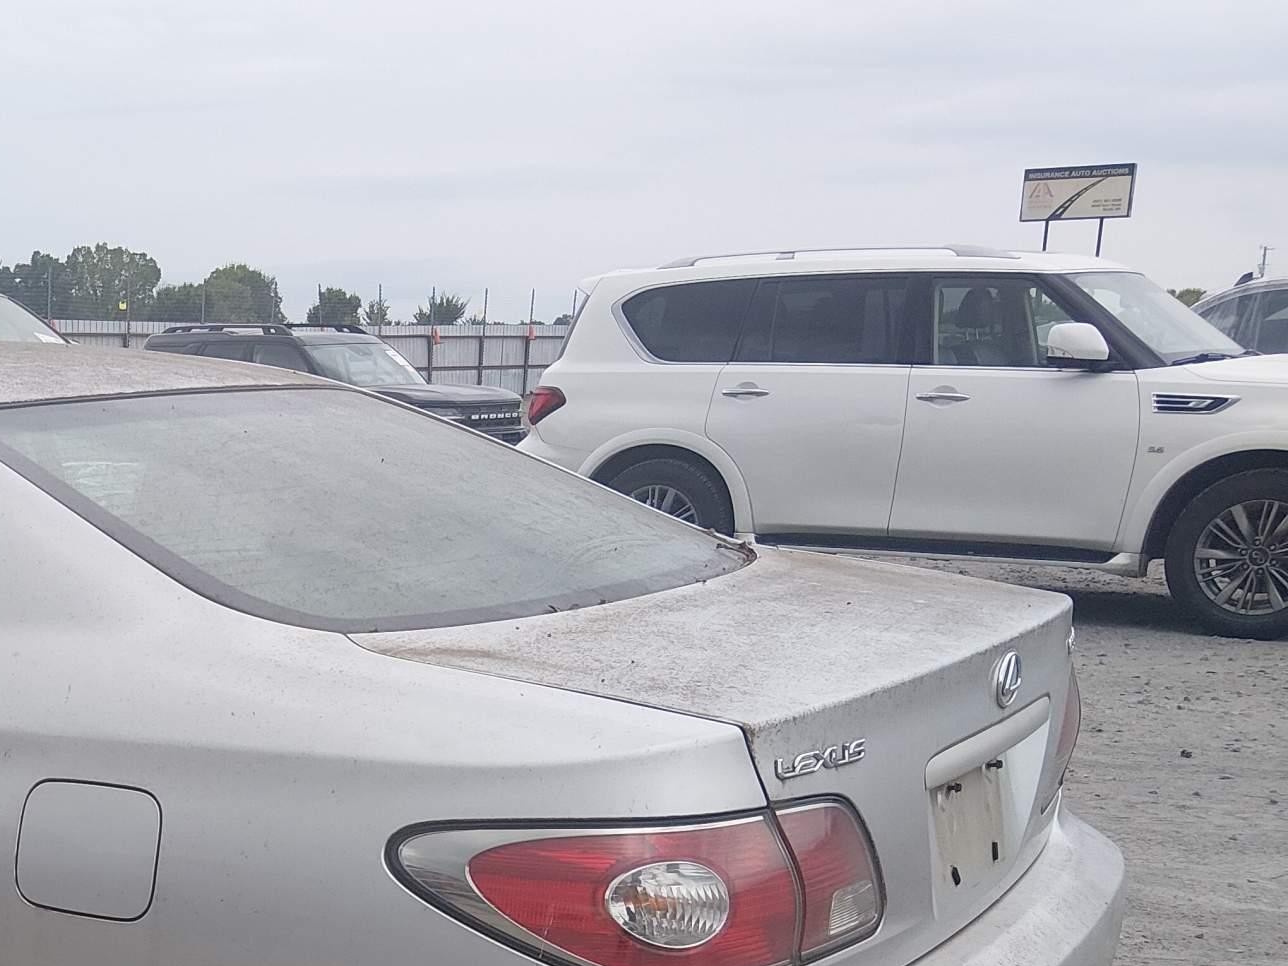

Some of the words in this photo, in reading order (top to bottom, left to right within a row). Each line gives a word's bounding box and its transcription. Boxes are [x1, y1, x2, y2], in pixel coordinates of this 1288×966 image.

[1028, 171, 1069, 179] INSURANCE
[1091, 168, 1129, 176] AUCTIONS
[471, 412, 519, 420] BRONCO
[774, 739, 866, 780] LEXUS
